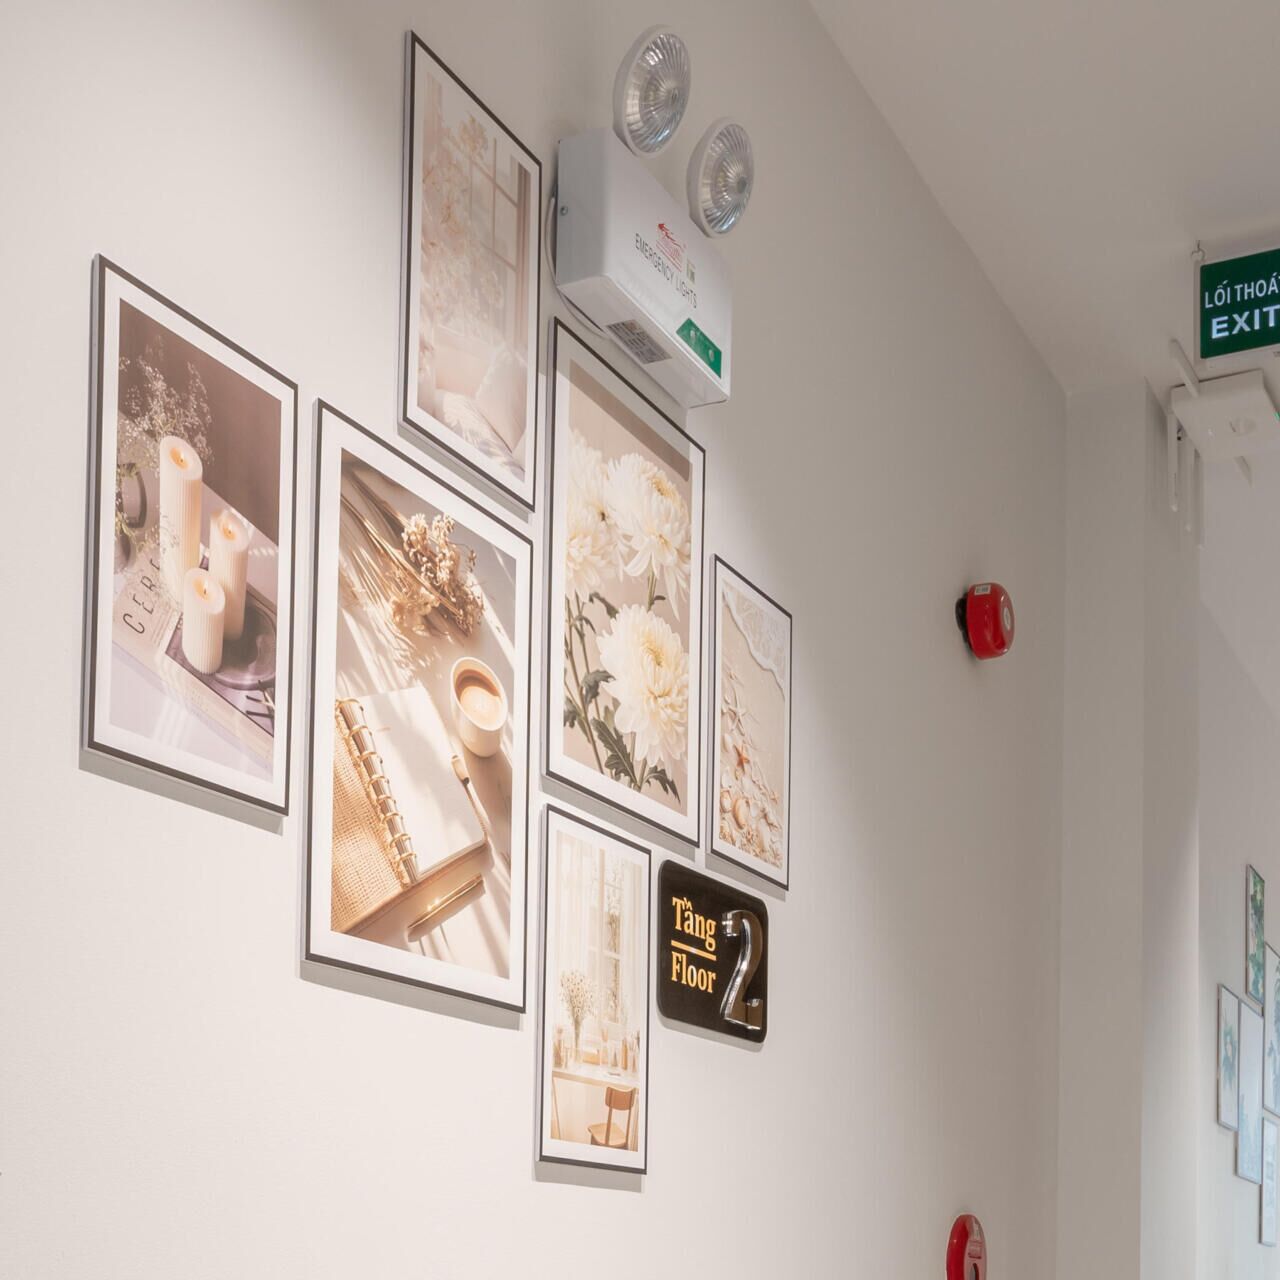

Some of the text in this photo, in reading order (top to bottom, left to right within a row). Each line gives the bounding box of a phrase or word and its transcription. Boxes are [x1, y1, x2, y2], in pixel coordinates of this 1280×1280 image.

[635, 232, 675, 285] EMERGENCY
[675, 272, 697, 309] LIGHTS
[1204, 279, 1231, 309] LỐI
[1211, 304, 1280, 339] EXIT
[671, 896, 717, 952] Tầng
[670, 950, 717, 994] Floor
[720, 909, 763, 1031] 2
